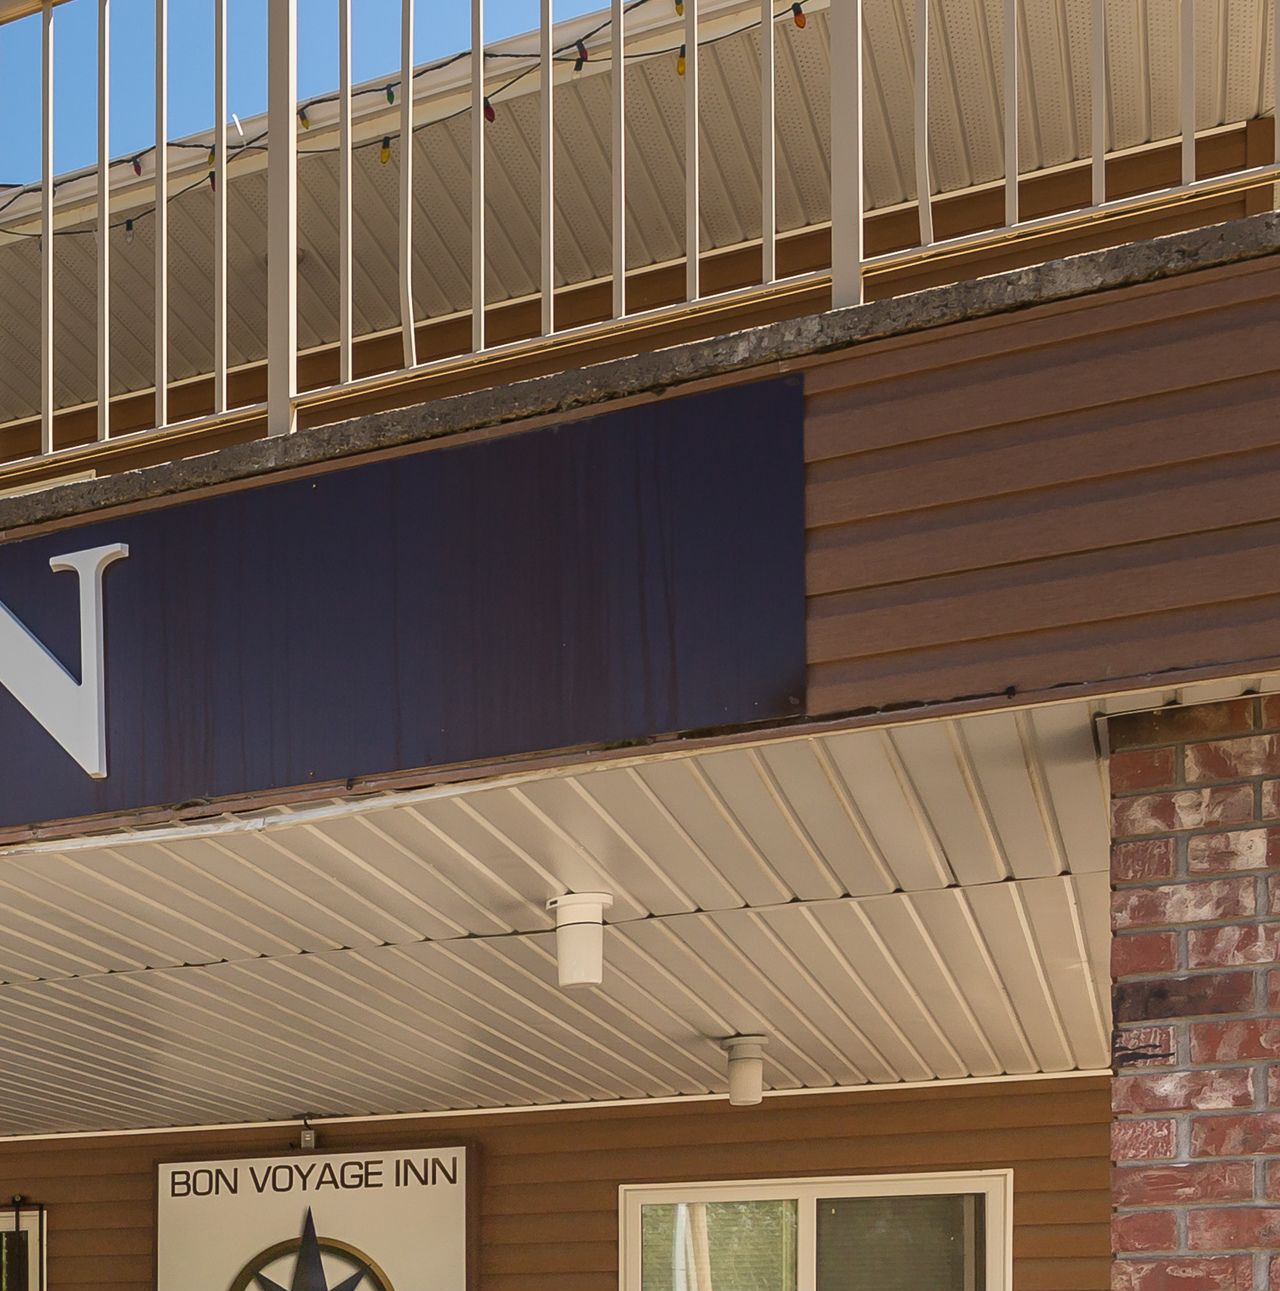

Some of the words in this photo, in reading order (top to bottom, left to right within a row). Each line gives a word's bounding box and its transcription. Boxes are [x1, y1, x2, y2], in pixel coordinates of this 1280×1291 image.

[171, 1168, 238, 1197] BON
[249, 1159, 383, 1193] VOYAGE
[395, 1156, 458, 1187] INN
